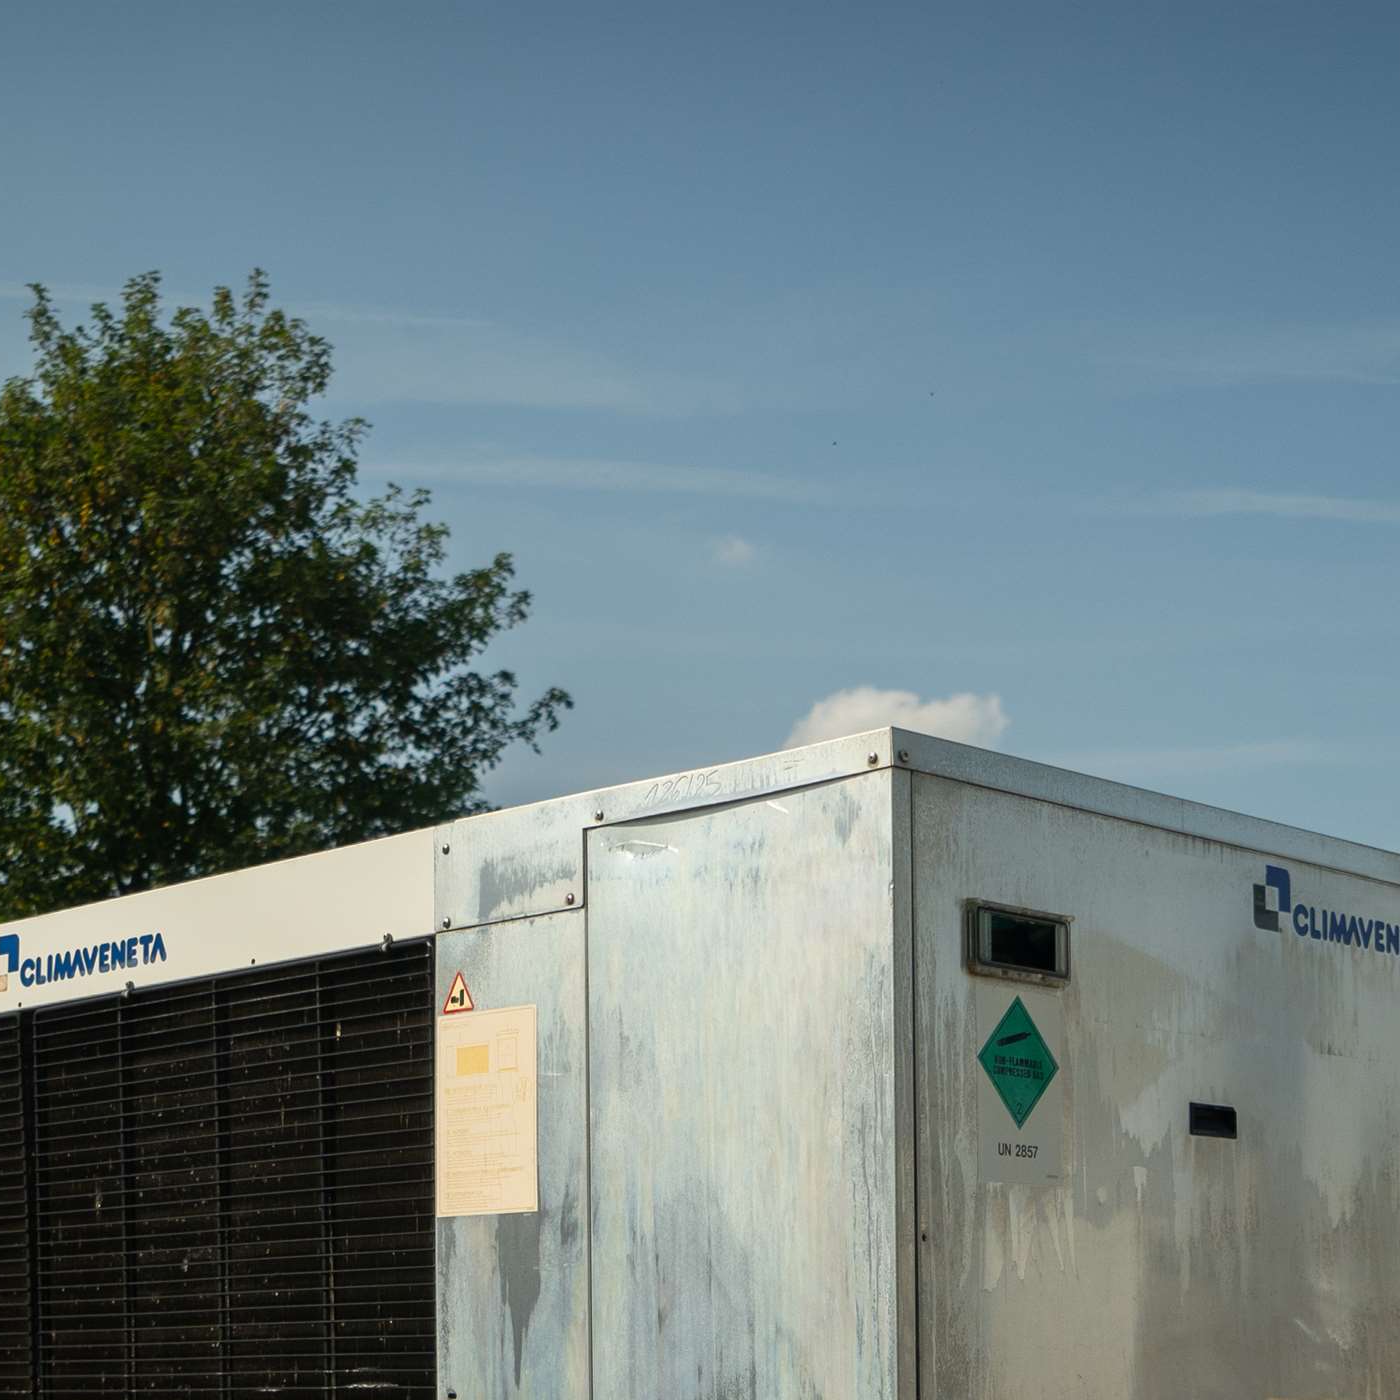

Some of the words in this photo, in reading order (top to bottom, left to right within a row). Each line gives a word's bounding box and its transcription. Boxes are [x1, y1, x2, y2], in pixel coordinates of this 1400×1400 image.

[20, 933, 167, 987] CLIMAVENETA
[1016, 1103, 1023, 1115] 2
[998, 1142, 1011, 1157] UN
[1015, 1144, 1039, 1159] 2857
